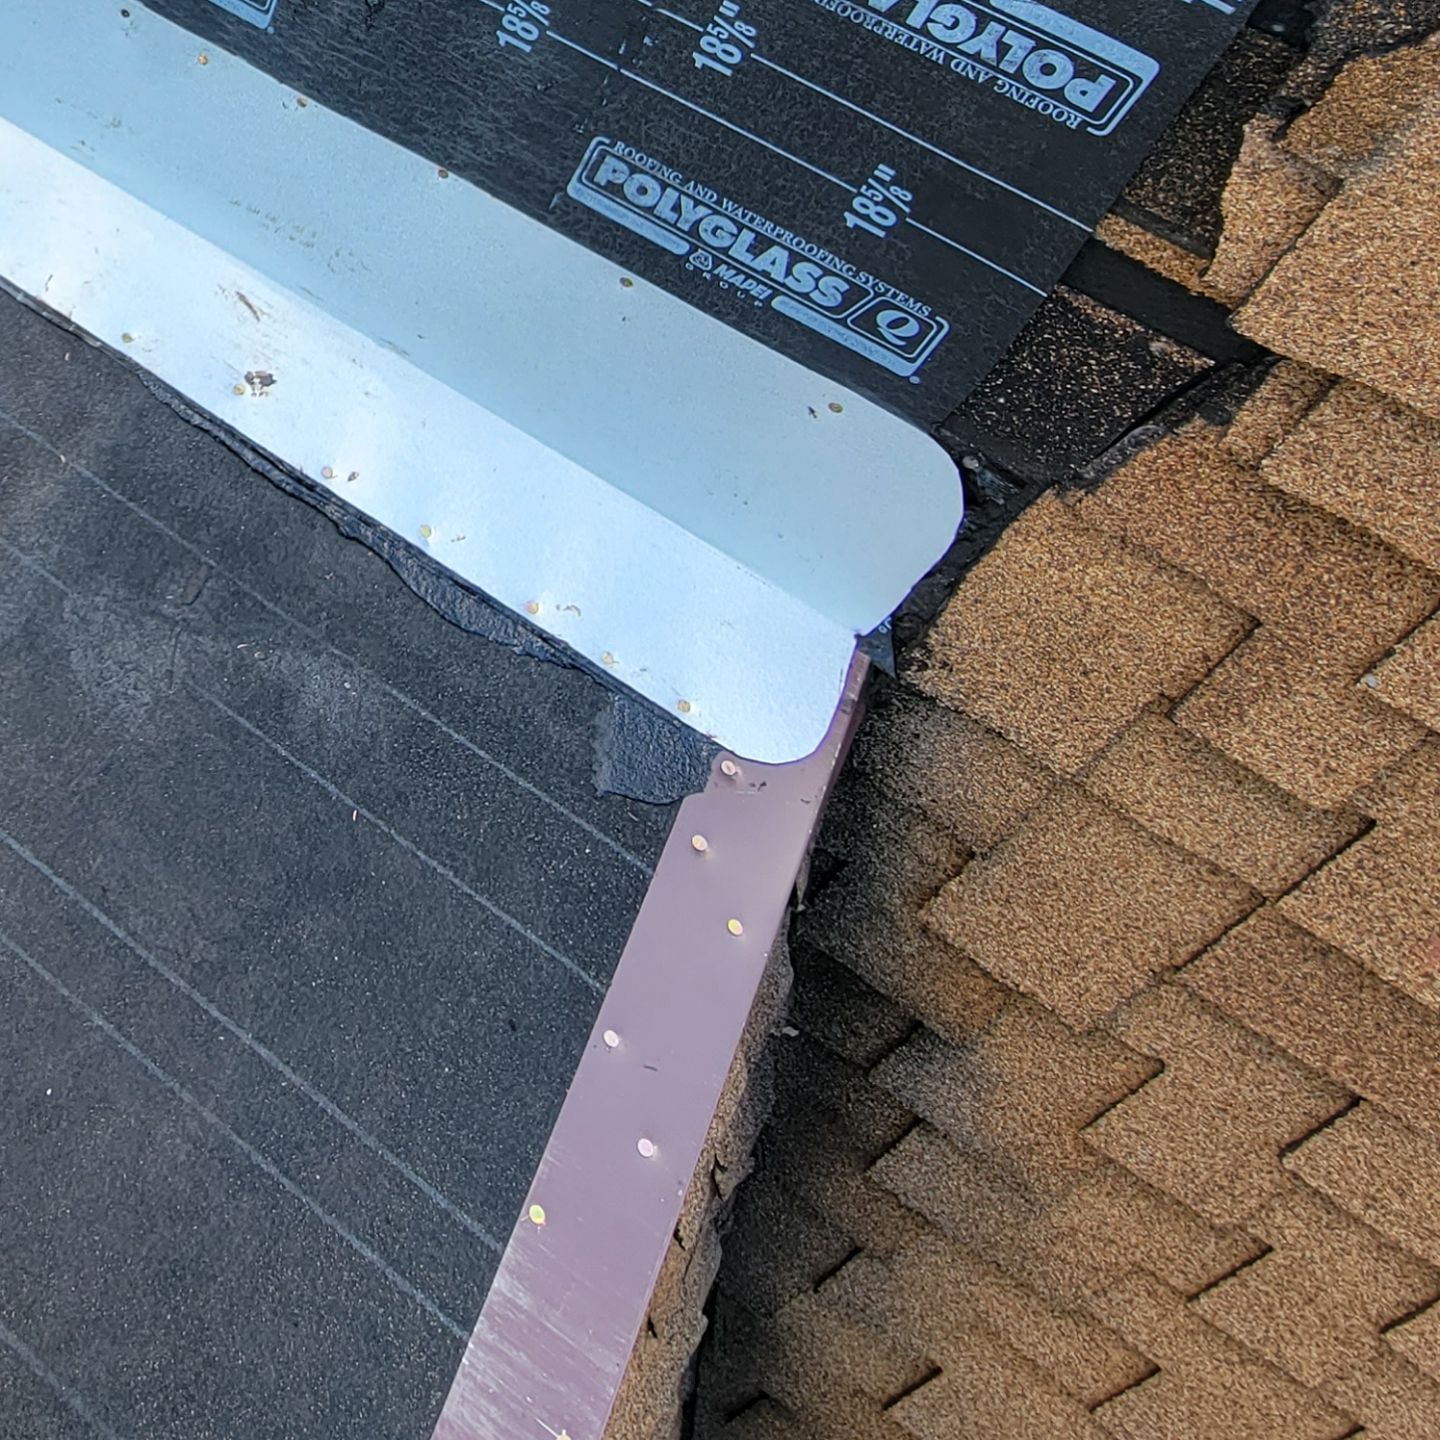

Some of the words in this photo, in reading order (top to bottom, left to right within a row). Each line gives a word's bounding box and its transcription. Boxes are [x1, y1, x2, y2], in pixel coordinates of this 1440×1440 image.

[949, 57, 993, 84] AND
[993, 77, 1083, 130] ROOFING
[593, 154, 850, 309] POLYGLASS
[613, 140, 684, 186] ROOFING
[684, 180, 718, 205] AND
[721, 195, 858, 277] WATERPROOFING
[857, 270, 933, 317] SYSTEMS
[712, 262, 774, 301] MAPEI
